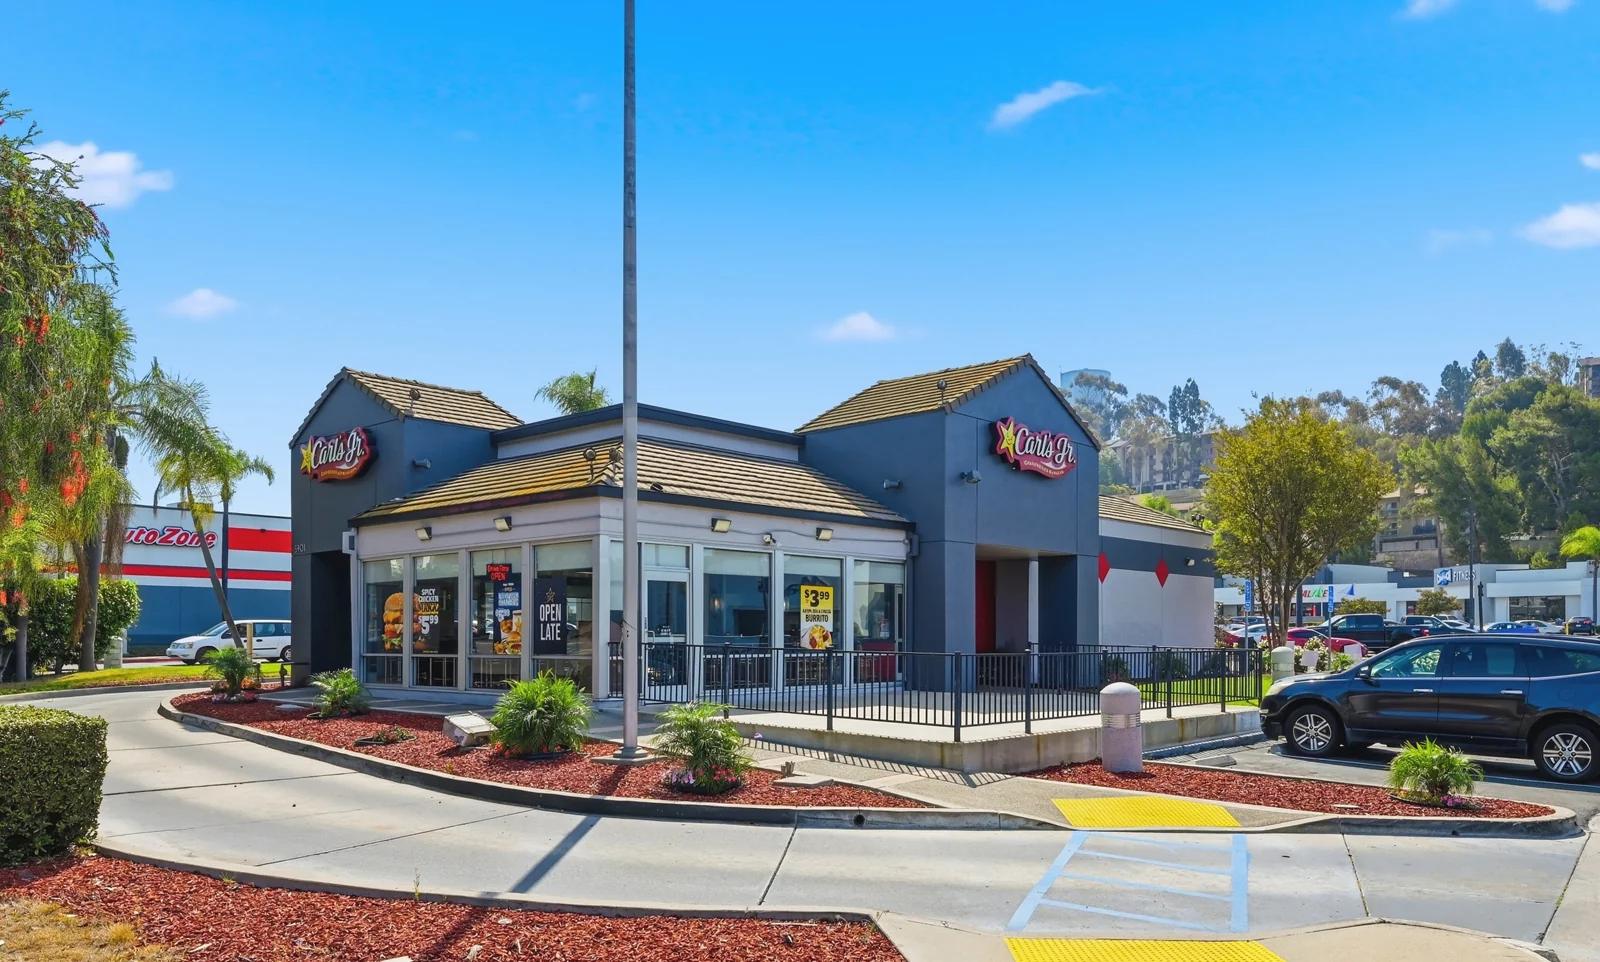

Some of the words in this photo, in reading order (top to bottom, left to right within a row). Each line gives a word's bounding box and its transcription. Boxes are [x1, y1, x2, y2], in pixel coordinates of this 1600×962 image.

[311, 435, 346, 469] Carl's
[345, 431, 364, 462] Jr.
[1015, 428, 1055, 458] Carl's
[1055, 437, 1076, 464] Jr.
[490, 572, 506, 581] OPEN
[421, 588, 436, 596] SPICY
[539, 603, 562, 622] OPEN
[805, 614, 829, 622] BURRITO
[540, 623, 562, 641] LATE
